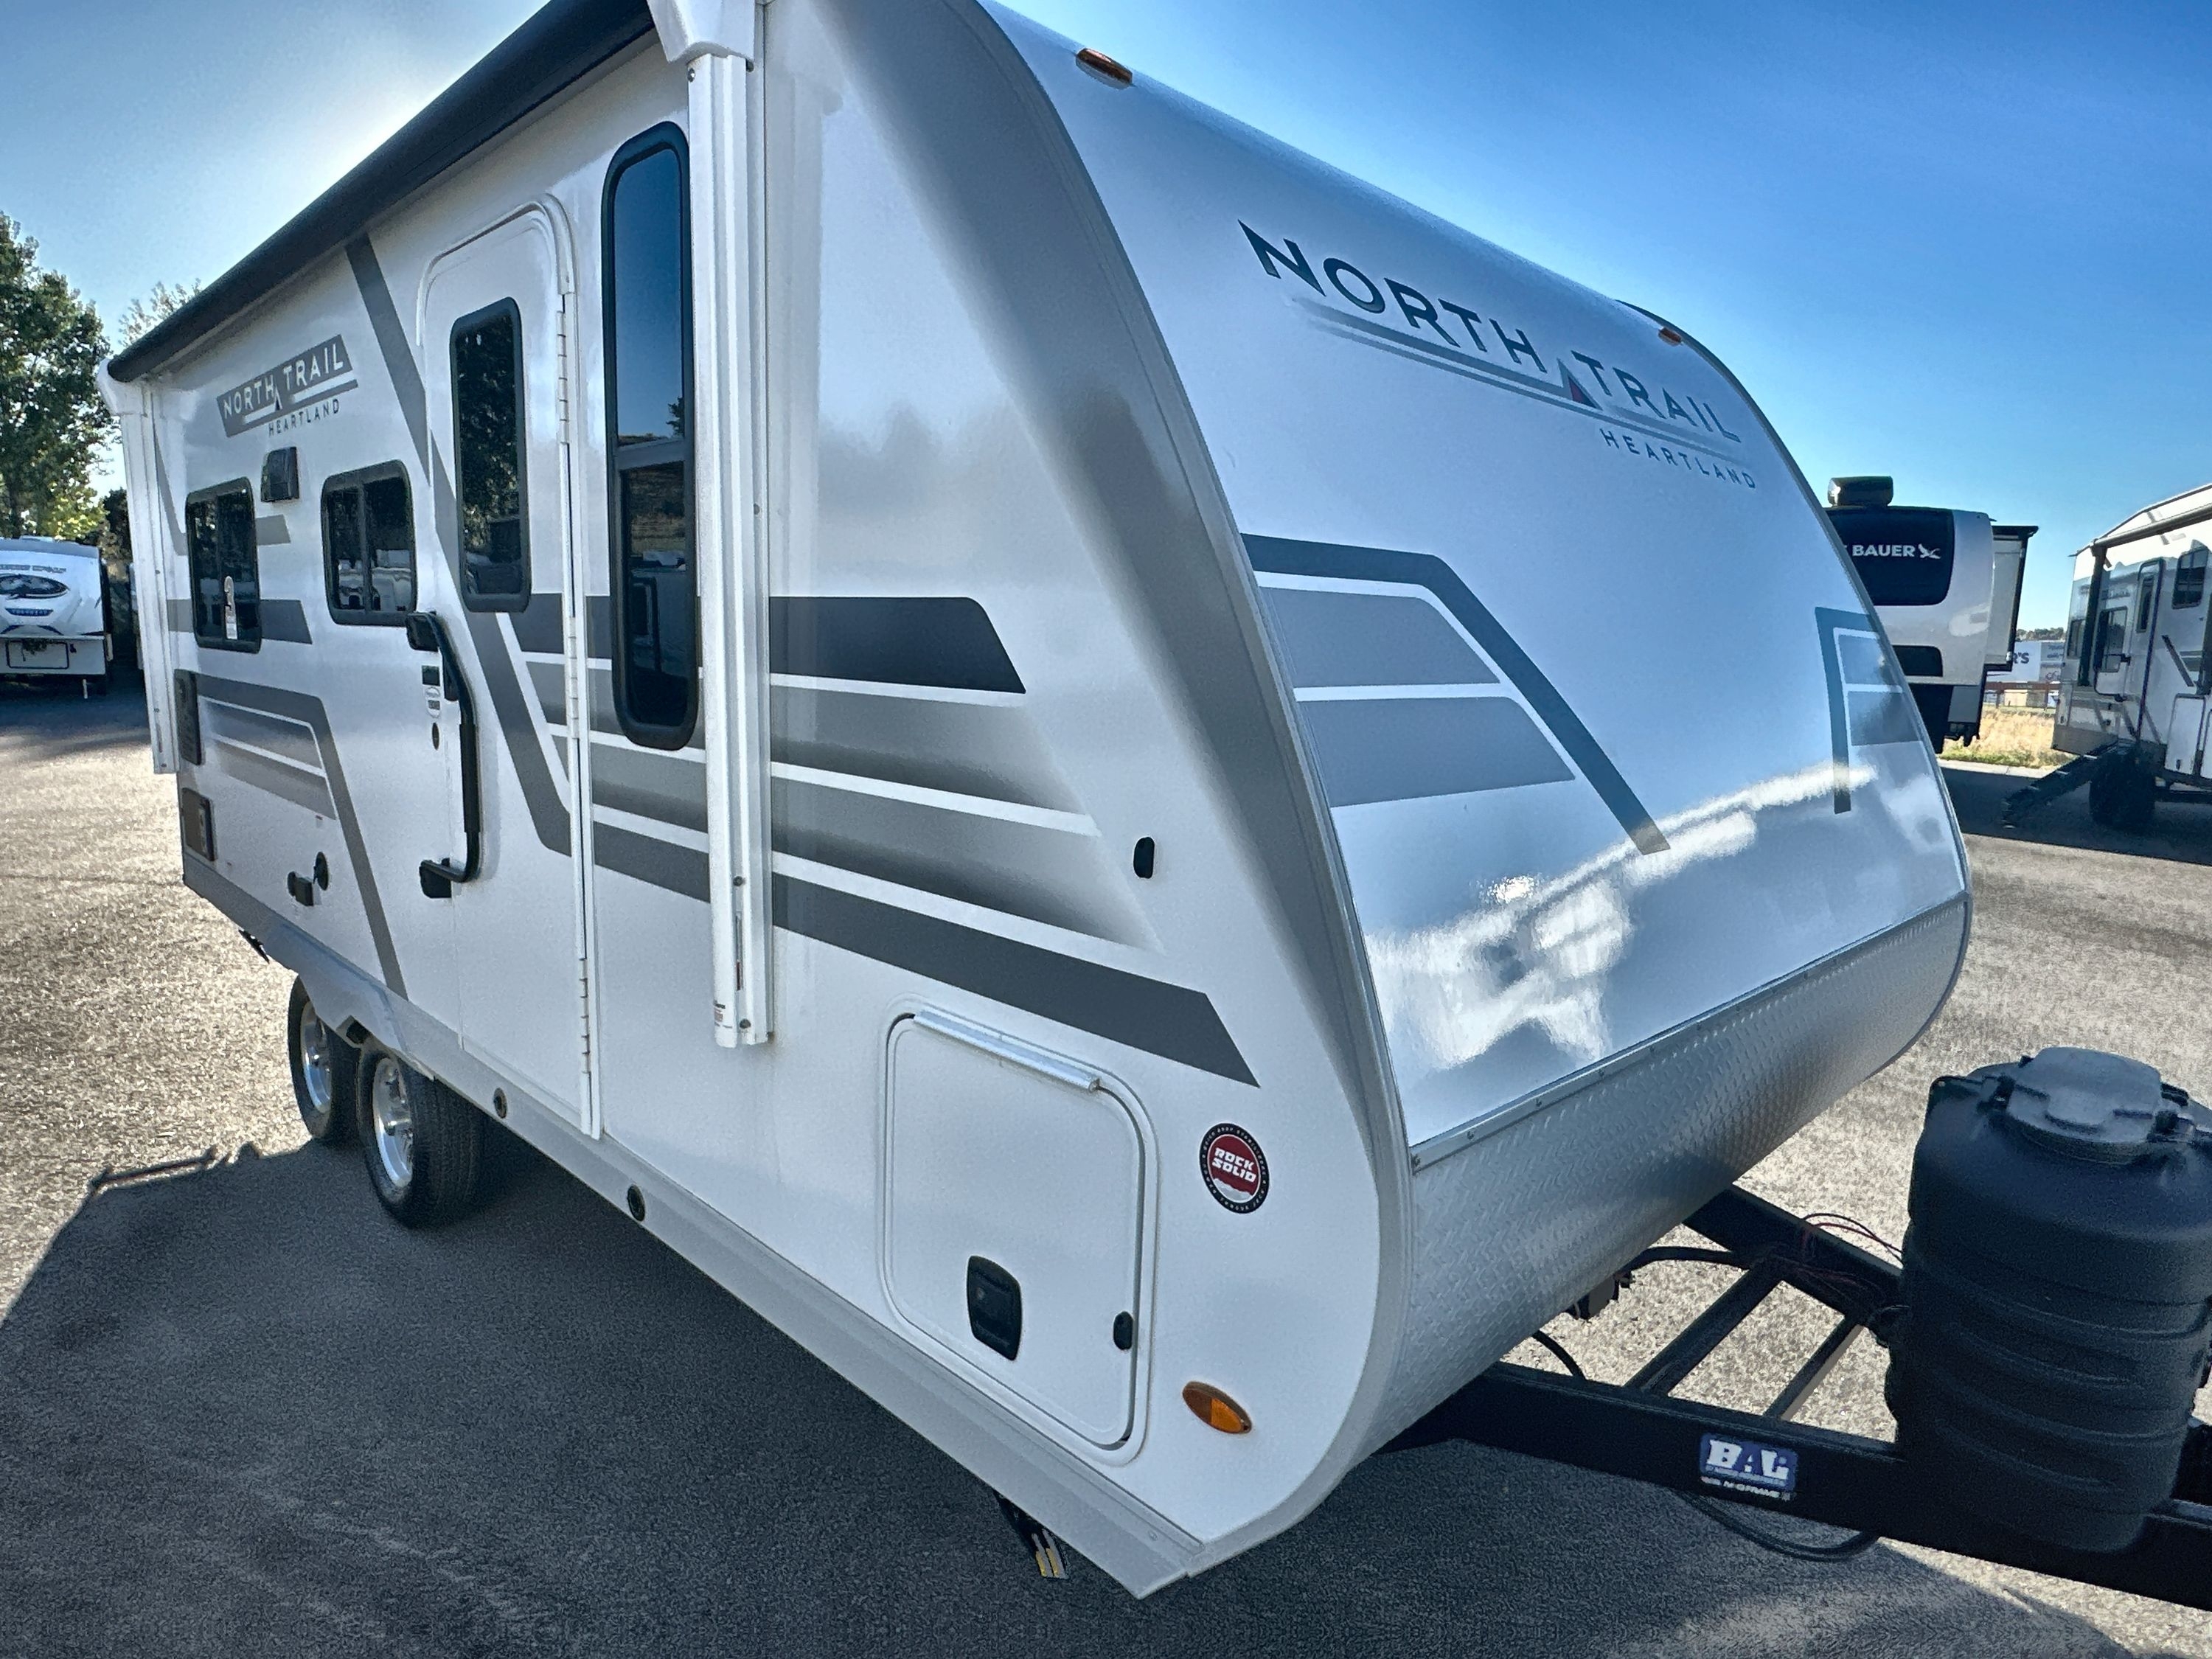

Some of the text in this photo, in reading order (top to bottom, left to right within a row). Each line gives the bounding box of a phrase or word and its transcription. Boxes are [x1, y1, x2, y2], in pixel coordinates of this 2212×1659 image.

[1237, 219, 1742, 442] NORTH TRAIL
[223, 344, 344, 420] NORTH TRAIL
[268, 399, 340, 437] HEARTLAND
[1599, 428, 1756, 489] HEARTLAND
[1851, 544, 1916, 557] BAUER
[1211, 1157, 1256, 1183] SOLID
[1214, 1147, 1255, 1171] ROCK
